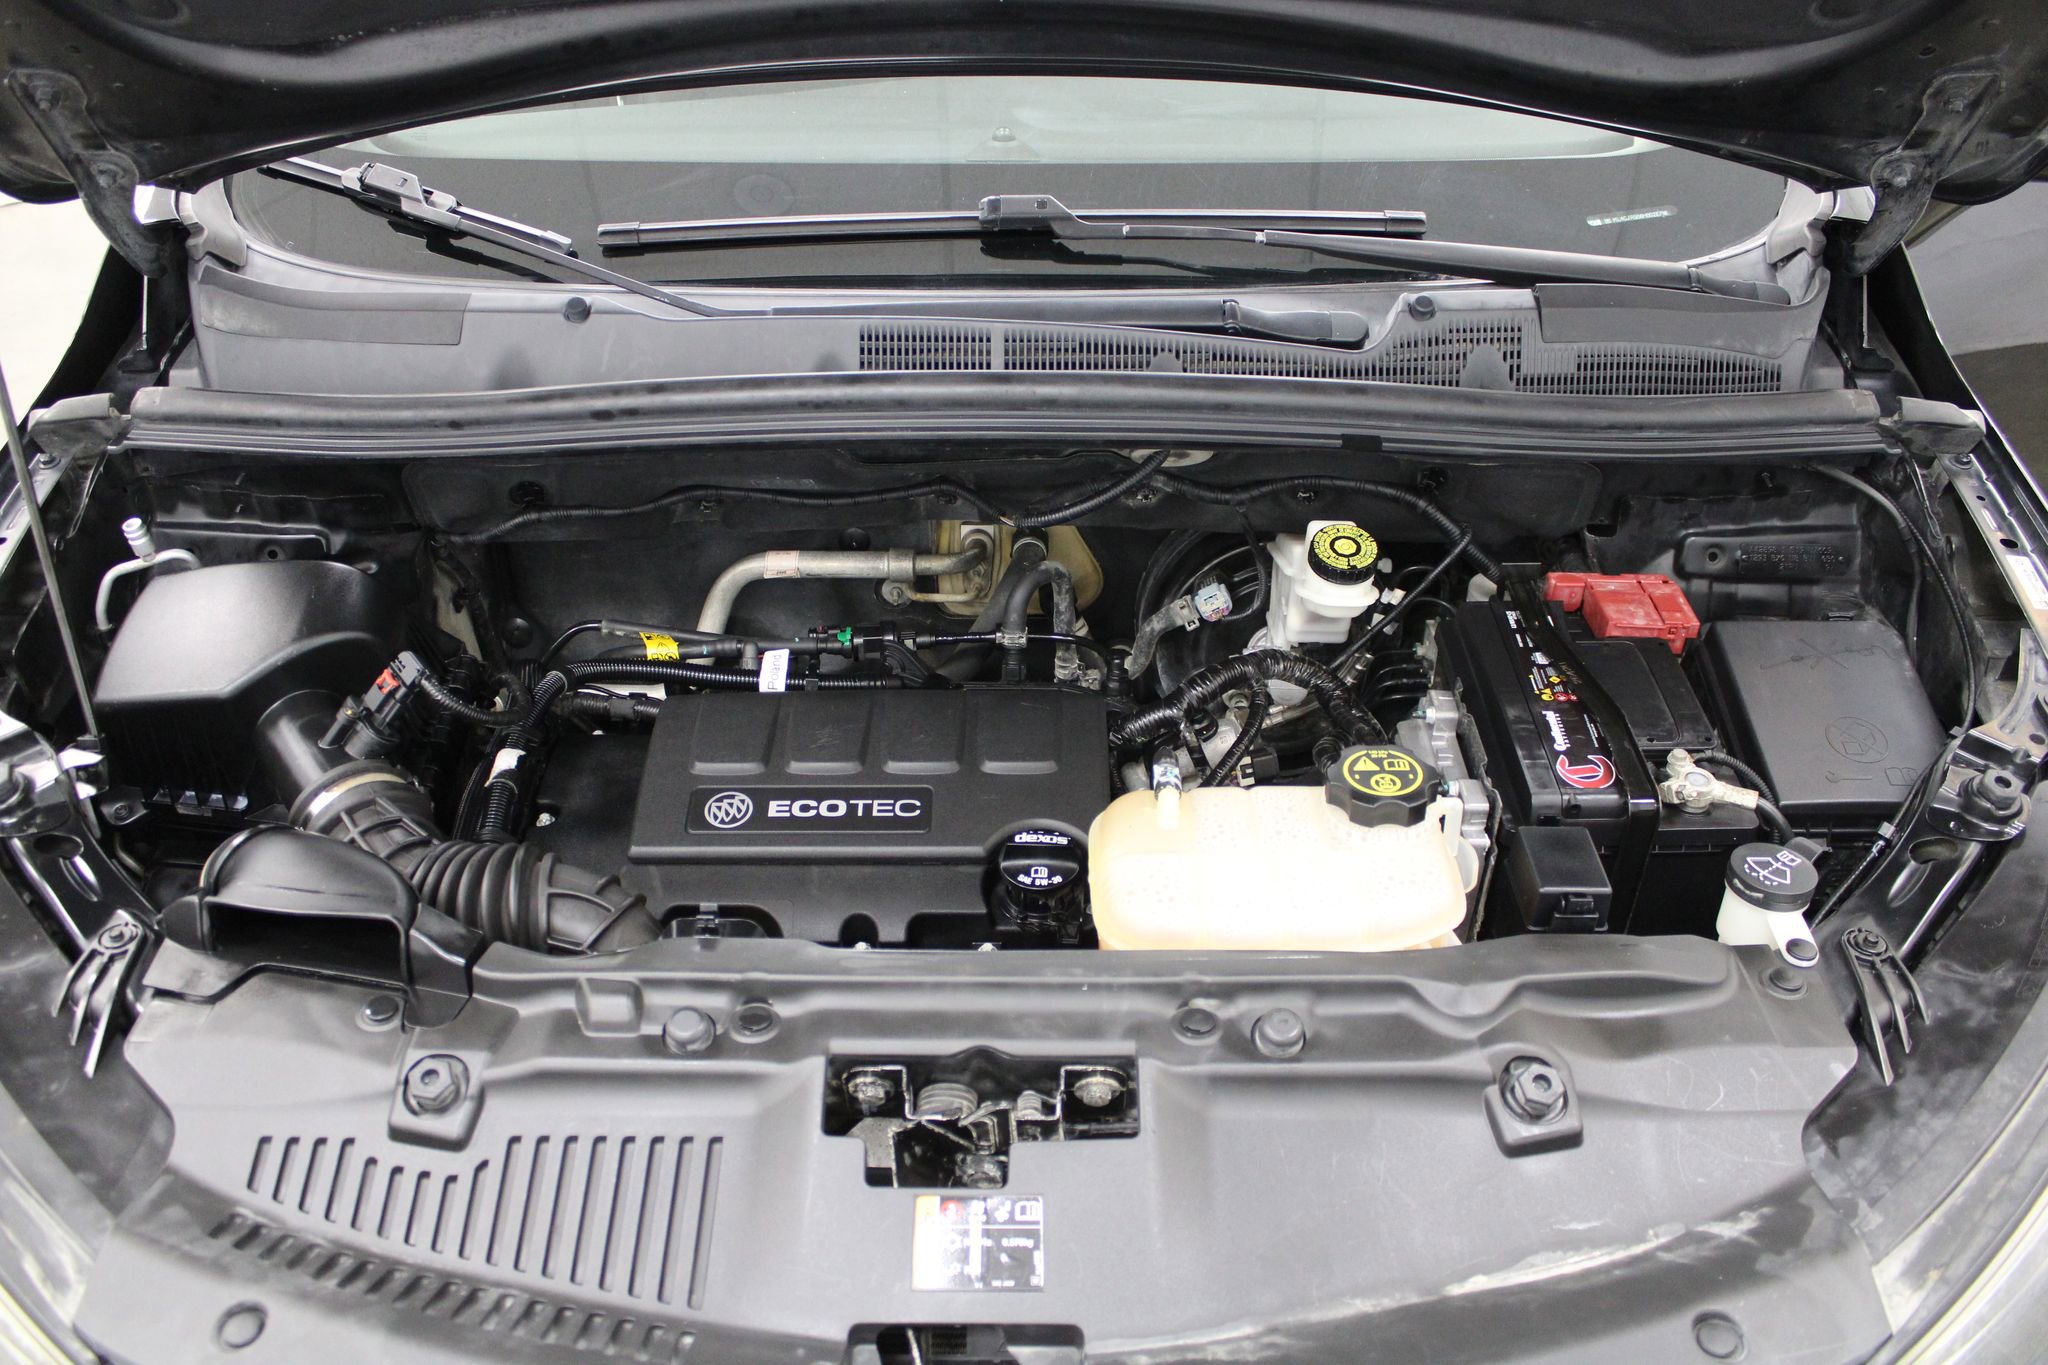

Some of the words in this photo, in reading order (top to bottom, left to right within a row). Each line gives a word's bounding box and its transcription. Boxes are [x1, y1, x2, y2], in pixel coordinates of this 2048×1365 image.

[767, 654, 782, 690] Poland
[767, 799, 921, 817] ECOTEC
[1014, 832, 1068, 845] dexos
[1017, 873, 1033, 885] SAE
[1035, 875, 1063, 886] 5W-30
